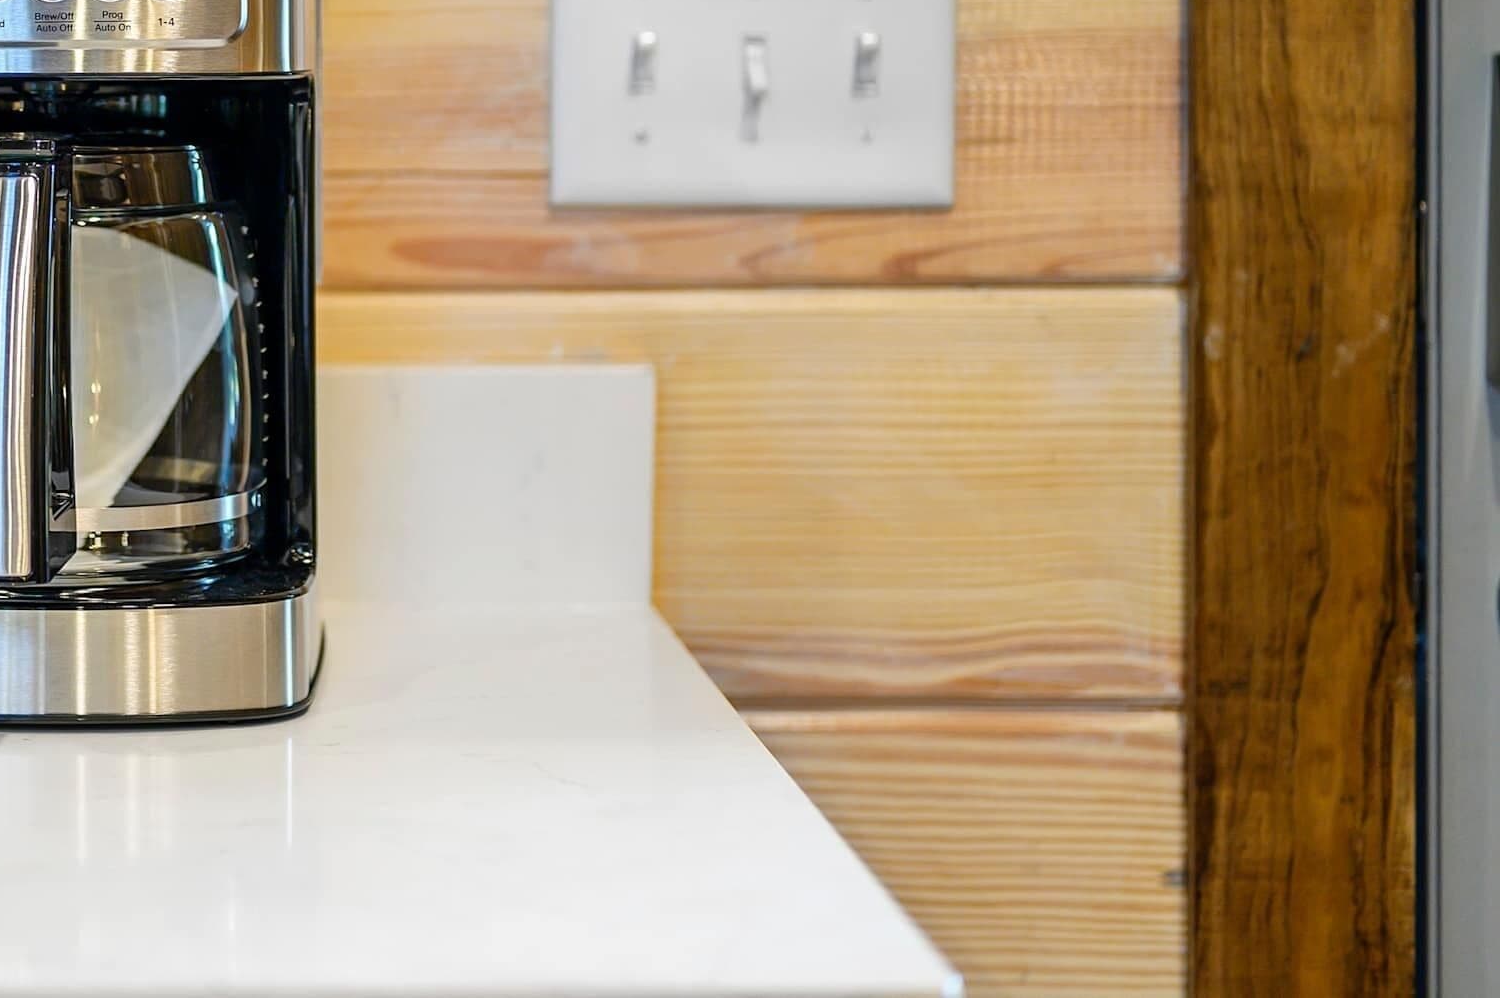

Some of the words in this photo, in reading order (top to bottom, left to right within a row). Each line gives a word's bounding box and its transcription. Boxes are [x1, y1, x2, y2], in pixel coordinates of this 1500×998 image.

[34, 11, 75, 22] Brew/Off
[102, 10, 124, 22] Prog
[36, 22, 56, 33] Auto
[58, 22, 74, 33] Off
[95, 21, 115, 33] Auto
[118, 22, 132, 33] On
[158, 17, 175, 27] 1-4
